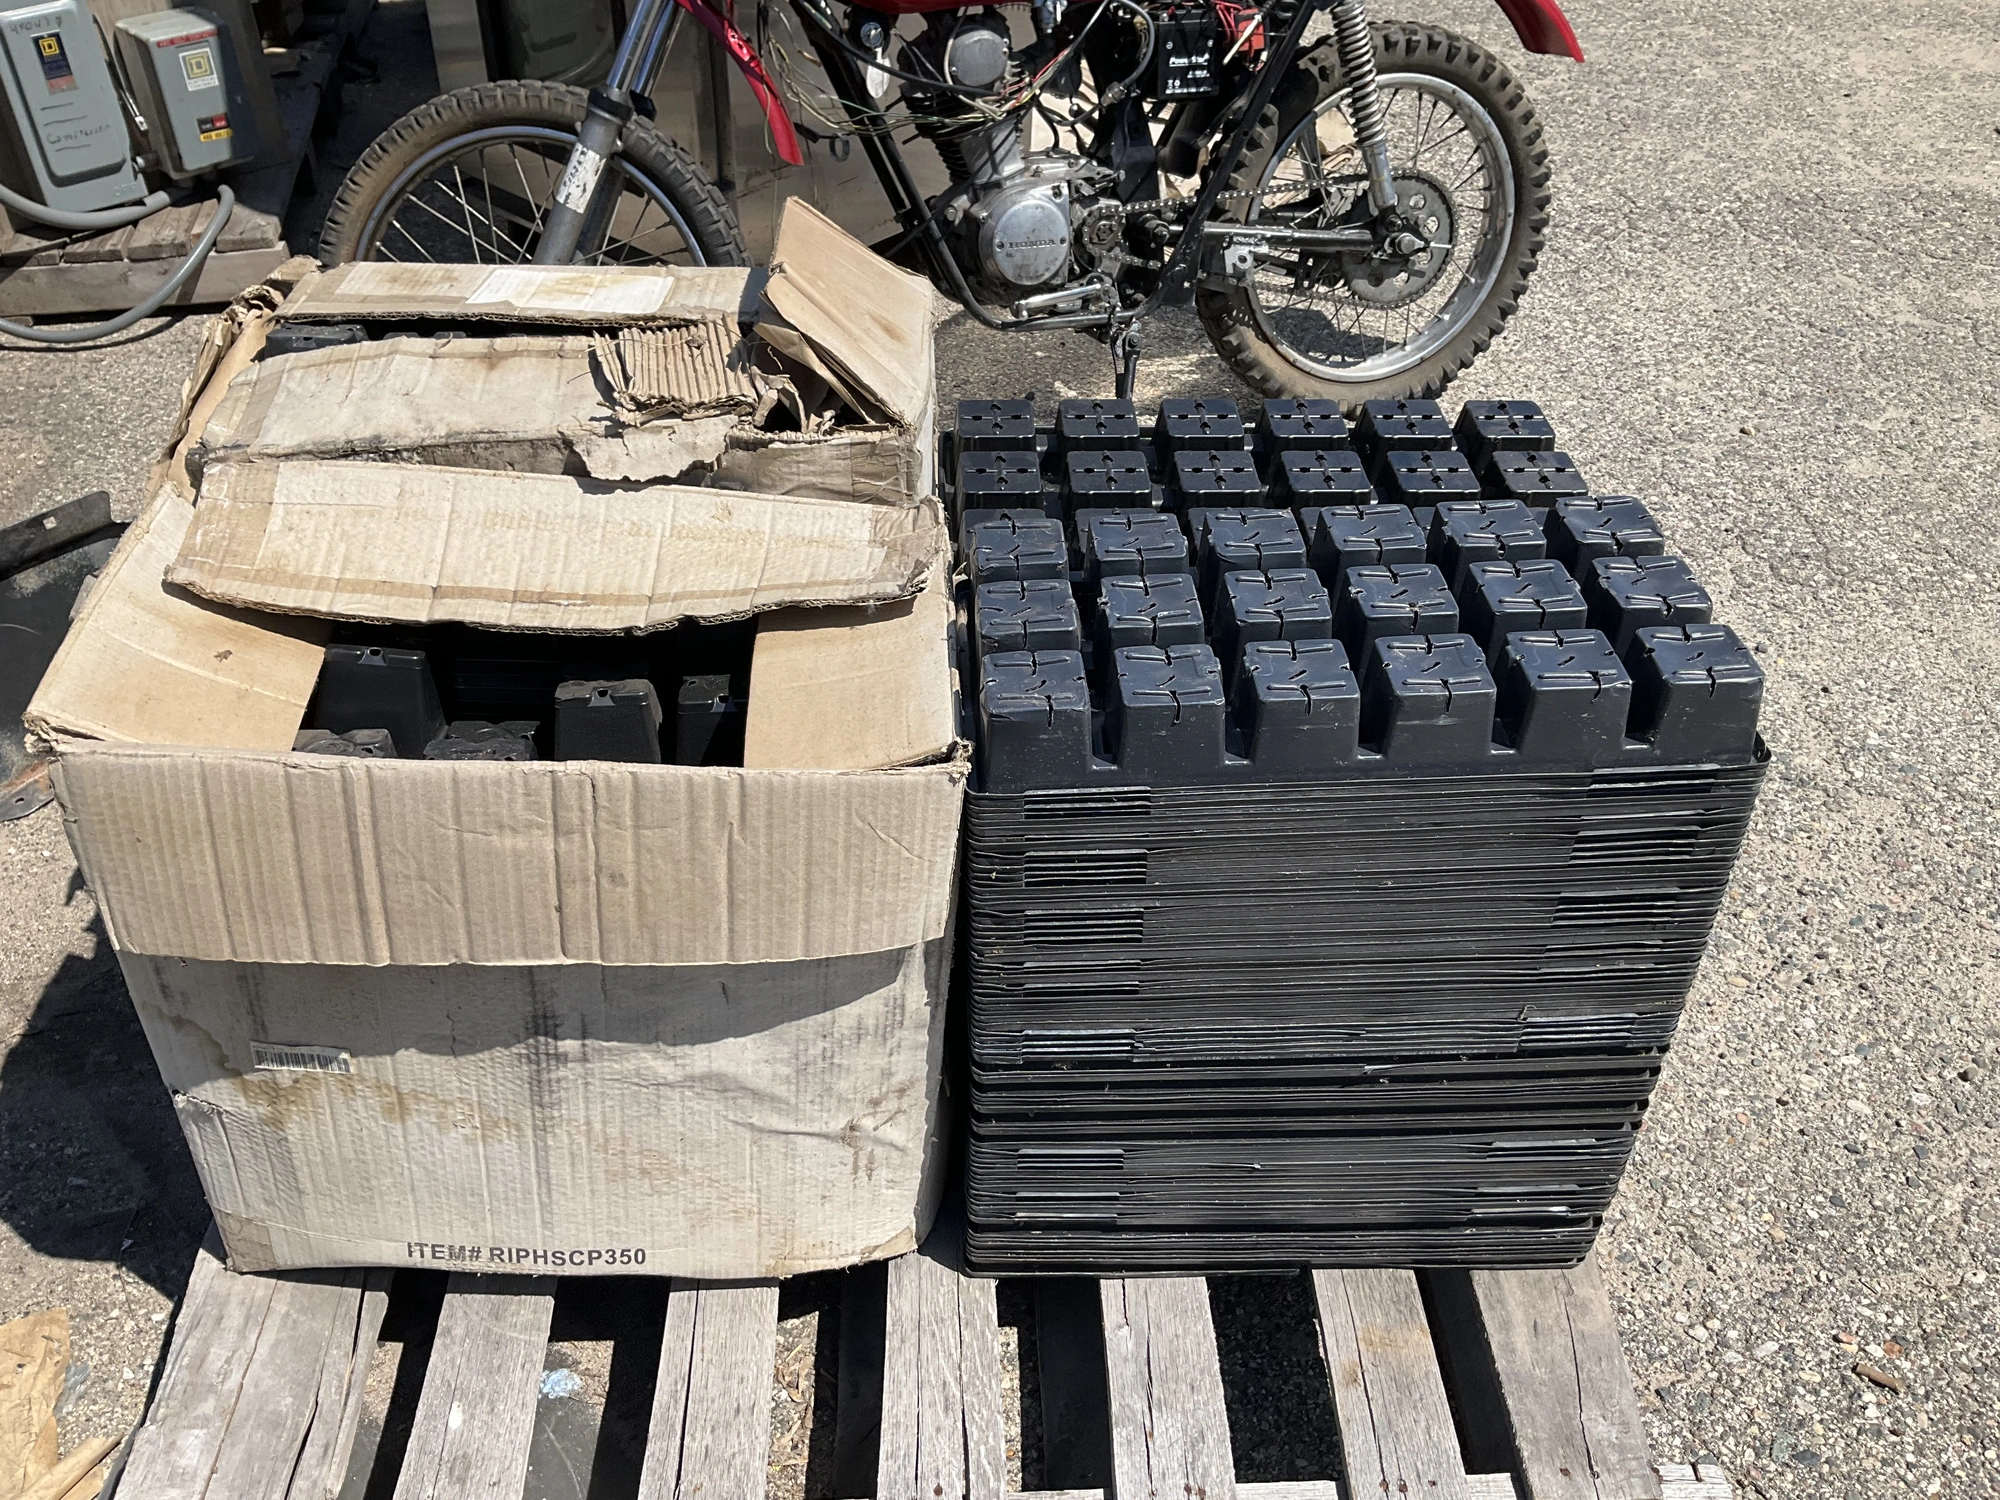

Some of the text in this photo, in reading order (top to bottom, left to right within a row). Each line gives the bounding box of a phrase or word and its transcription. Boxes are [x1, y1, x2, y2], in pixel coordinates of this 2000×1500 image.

[1008, 239, 1056, 249] HONDA
[407, 1242, 647, 1267] ITEM# RIPHSCP350
